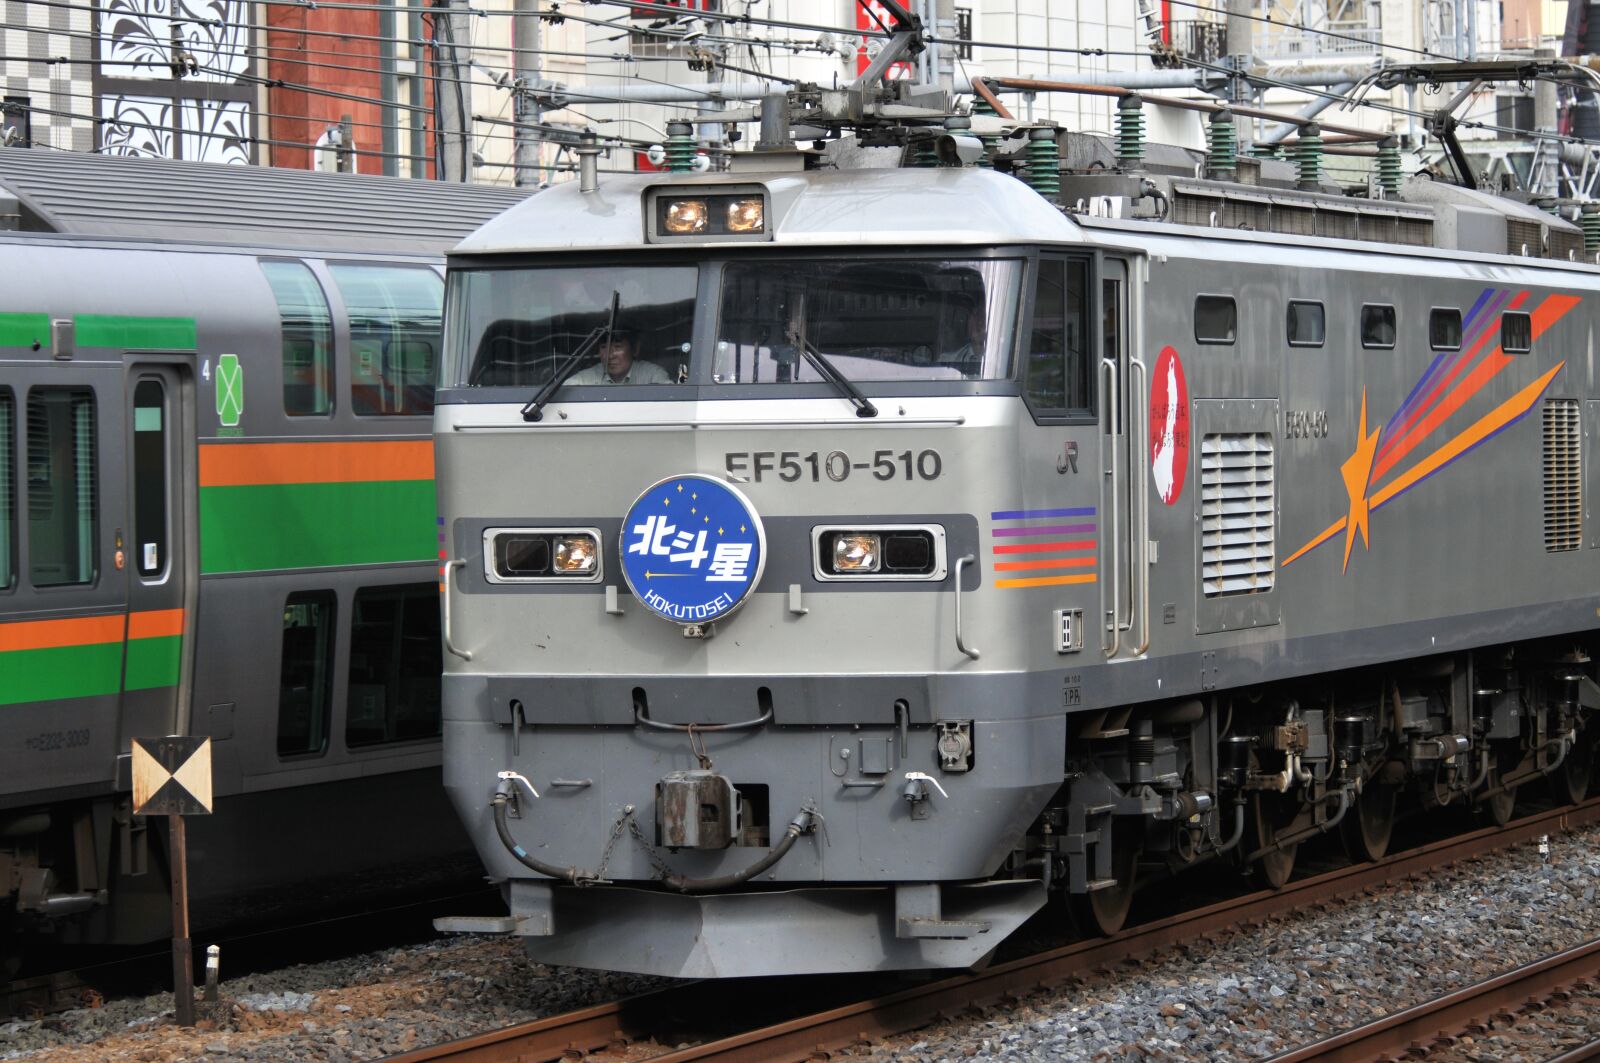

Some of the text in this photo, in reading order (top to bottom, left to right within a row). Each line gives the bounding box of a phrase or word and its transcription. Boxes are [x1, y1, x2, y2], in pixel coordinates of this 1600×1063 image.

[202, 359, 211, 381] 4
[725, 448, 943, 484] EF510-510
[1056, 441, 1079, 475] JR
[628, 514, 753, 583] 北斗星
[644, 587, 734, 619] HOKUTOSEI
